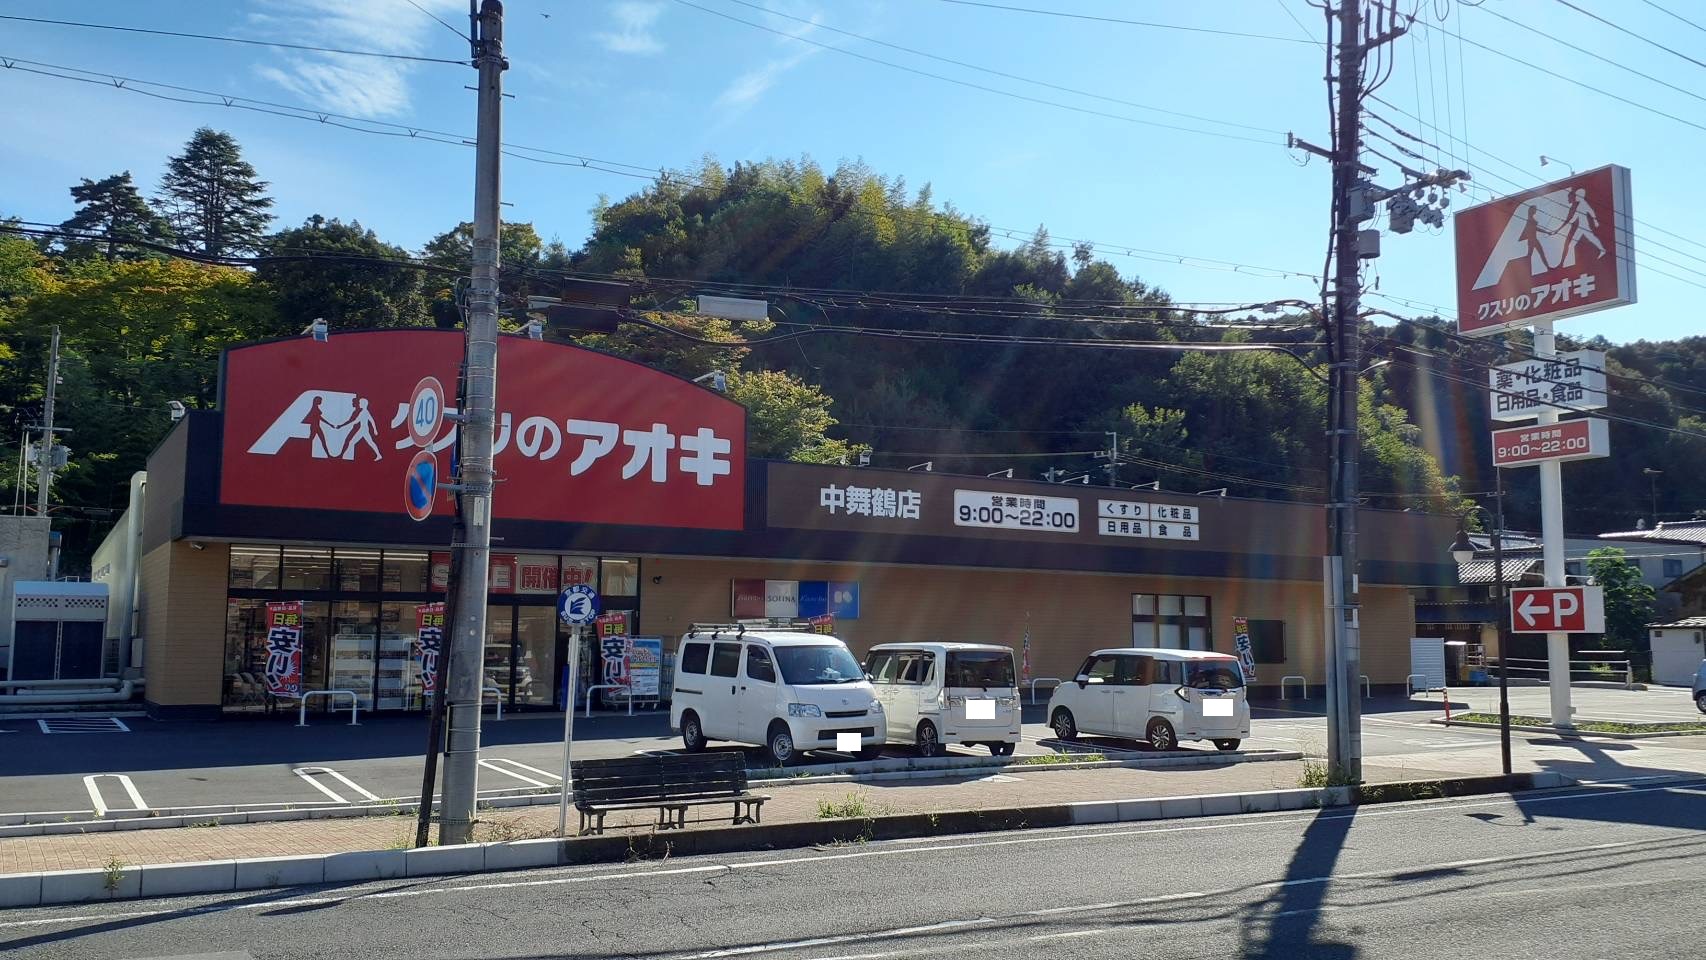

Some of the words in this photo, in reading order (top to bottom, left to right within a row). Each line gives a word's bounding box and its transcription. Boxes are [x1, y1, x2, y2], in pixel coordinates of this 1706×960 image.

[1477, 273, 1596, 320] クスリのアオキ
[1496, 381, 1583, 413] 日用品・食品
[415, 396, 434, 427] 40
[1498, 437, 1587, 458] 9:00～22:00
[820, 484, 921, 520] 中舞鶴店
[991, 495, 1056, 510] 営業時間
[1107, 503, 1141, 516] くすり
[959, 505, 1076, 529] 9:00～22:00
[1158, 507, 1191, 520] 化粧品
[1108, 521, 1142, 534] 日用品
[1159, 524, 1192, 537] 食品
[1553, 592, 1579, 627] P
